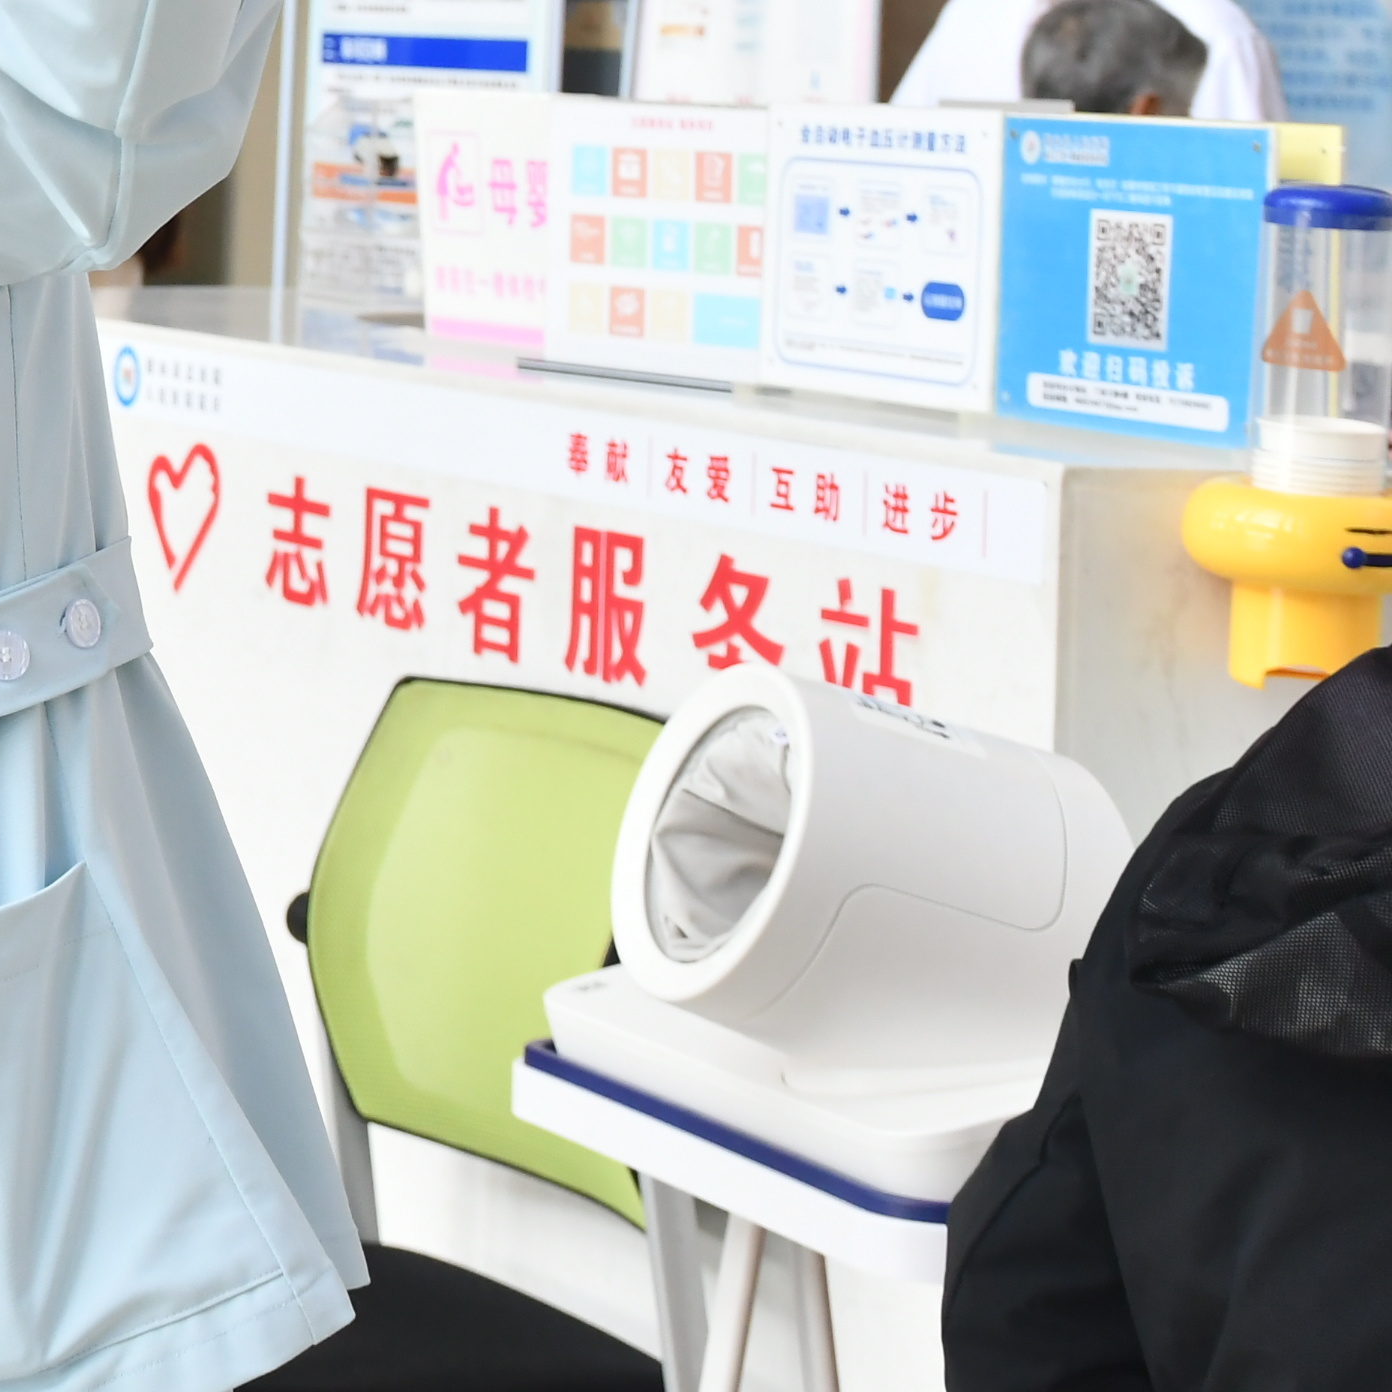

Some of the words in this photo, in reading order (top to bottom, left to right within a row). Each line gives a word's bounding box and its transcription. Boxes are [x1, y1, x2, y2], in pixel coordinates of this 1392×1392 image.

[487, 156, 549, 229] 母婴
[567, 431, 630, 488] 奉献
[665, 448, 732, 505] 友爱
[769, 466, 842, 523] 互助
[882, 483, 960, 542] 进步
[265, 476, 920, 707] 志愿者服务站
